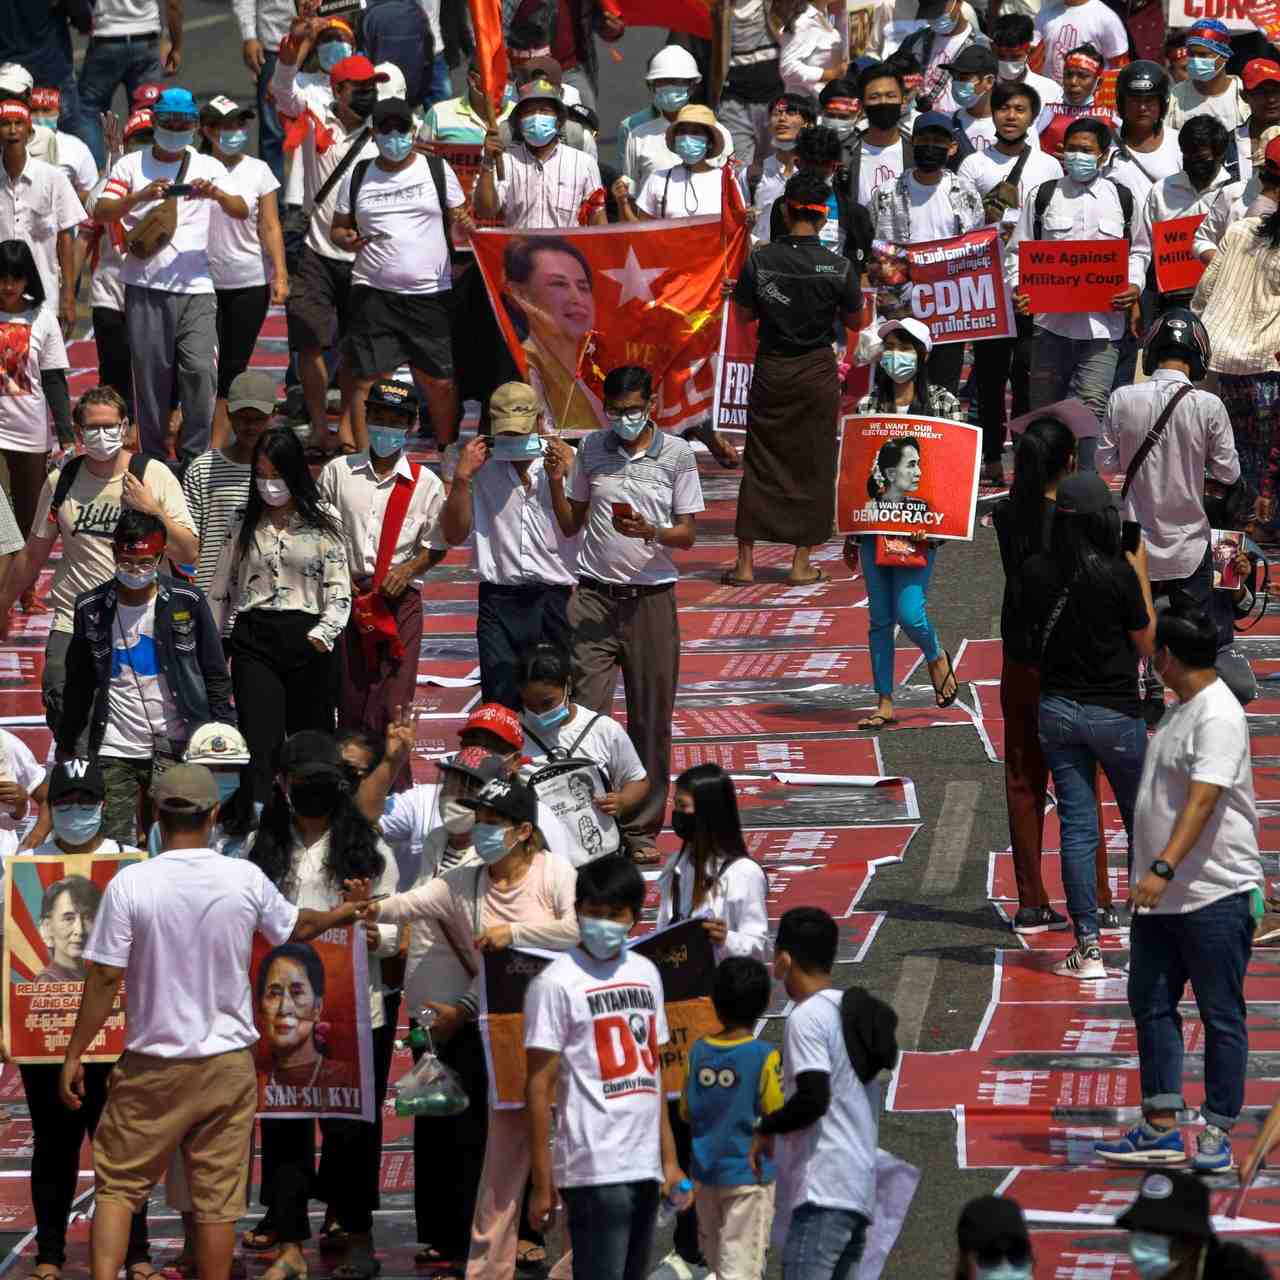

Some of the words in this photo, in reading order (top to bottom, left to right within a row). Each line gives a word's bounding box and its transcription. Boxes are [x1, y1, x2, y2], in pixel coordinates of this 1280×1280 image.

[1164, 230, 1188, 243] We
[1029, 251, 1055, 264] We
[1060, 251, 1119, 266] Against
[1022, 273, 1081, 287] Military
[1085, 273, 1125, 287] Coup
[911, 274, 997, 319] CDM
[870, 422, 881, 431] WE
[884, 422, 910, 431] WANT
[913, 423, 933, 432] OUR
[889, 429, 944, 440] GOVERNMENT
[879, 501, 905, 512] WANT
[906, 502, 928, 512] OUR
[852, 509, 945, 526] DEMOCRACY
[64, 758, 89, 779] W
[17, 983, 66, 994] RELEASE
[67, 982, 85, 993] OU
[31, 997, 61, 1009] AUNG
[328, 1086, 361, 1109] KYI
